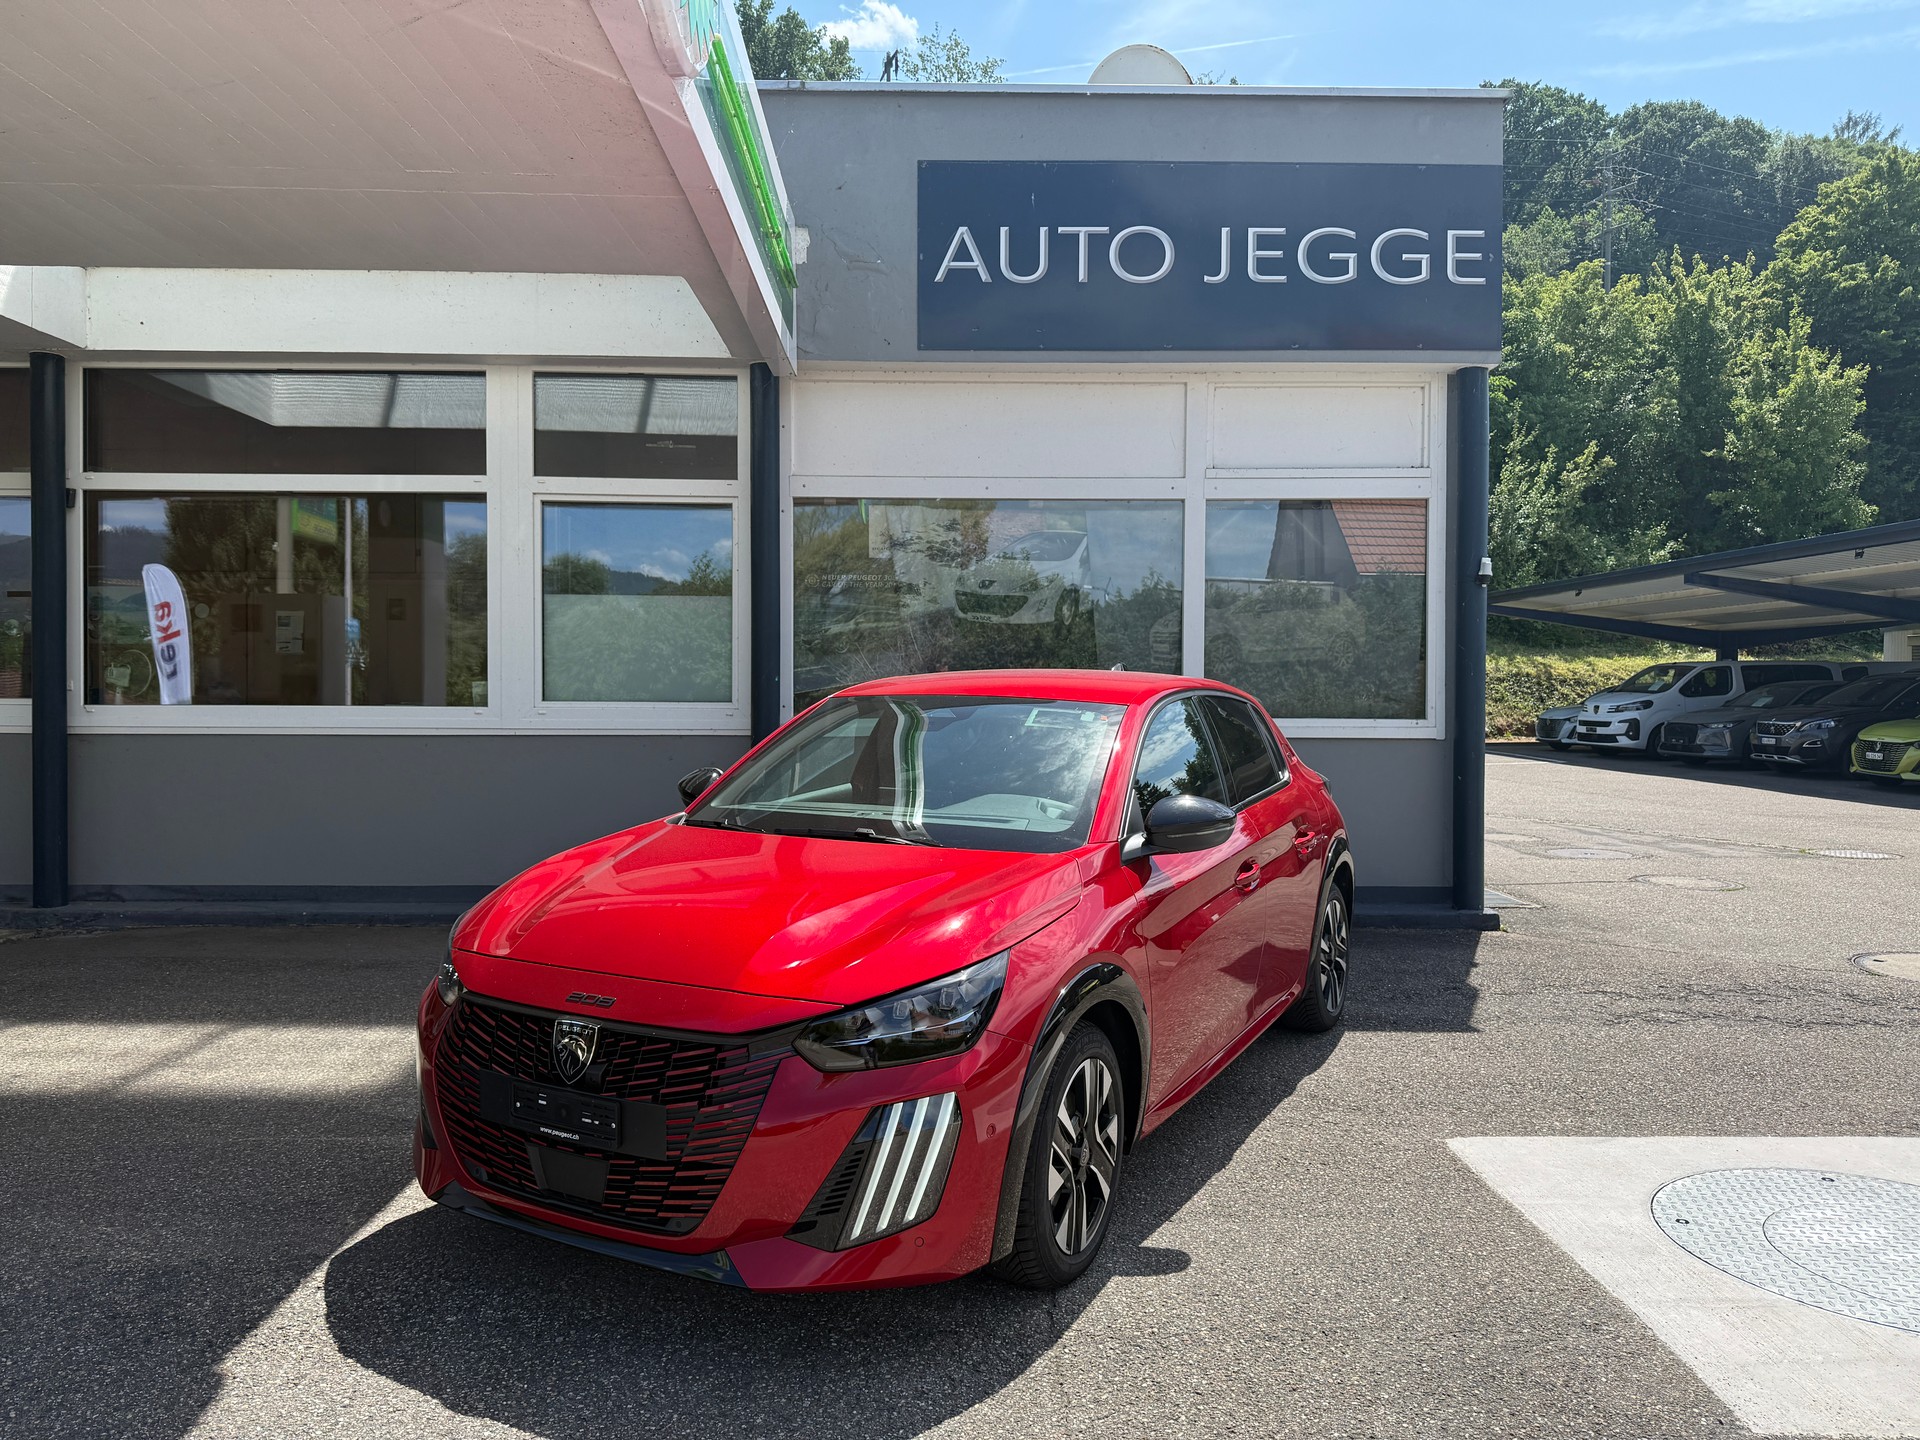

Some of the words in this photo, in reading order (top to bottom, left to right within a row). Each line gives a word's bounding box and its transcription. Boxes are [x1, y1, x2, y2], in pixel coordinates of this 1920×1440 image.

[934, 225, 1176, 285] AUTO
[1203, 226, 1487, 286] JEGGE
[565, 991, 617, 1009] 208
[557, 1024, 594, 1037] PEUGEOT
[539, 1126, 580, 1141] www.peugeot.ch
